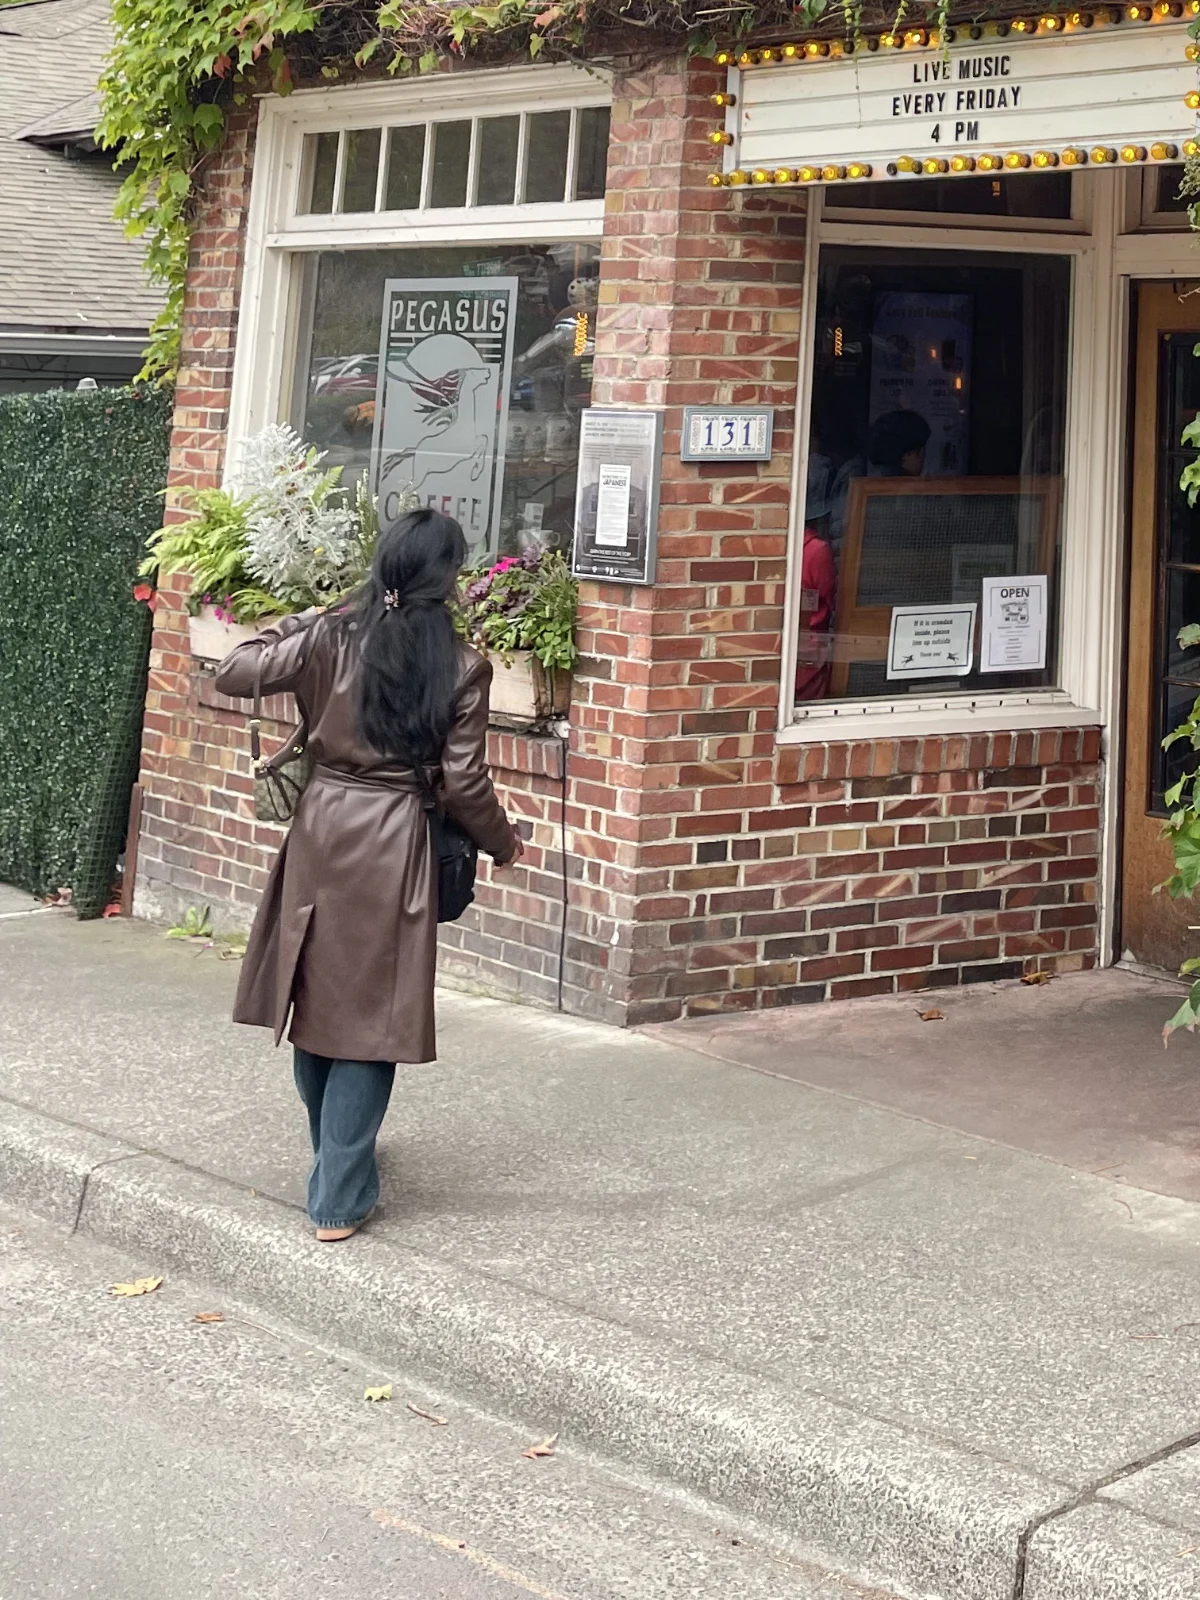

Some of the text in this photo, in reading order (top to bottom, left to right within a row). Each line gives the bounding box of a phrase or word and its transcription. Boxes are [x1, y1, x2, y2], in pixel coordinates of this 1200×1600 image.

[914, 55, 1010, 83] LIVE MUSIC
[892, 86, 1021, 116] EVERY FRIDAY
[931, 121, 979, 142] 4 PM
[390, 299, 507, 332] PEGASUS
[705, 422, 751, 447] 131
[1000, 588, 1030, 599] OPEN
